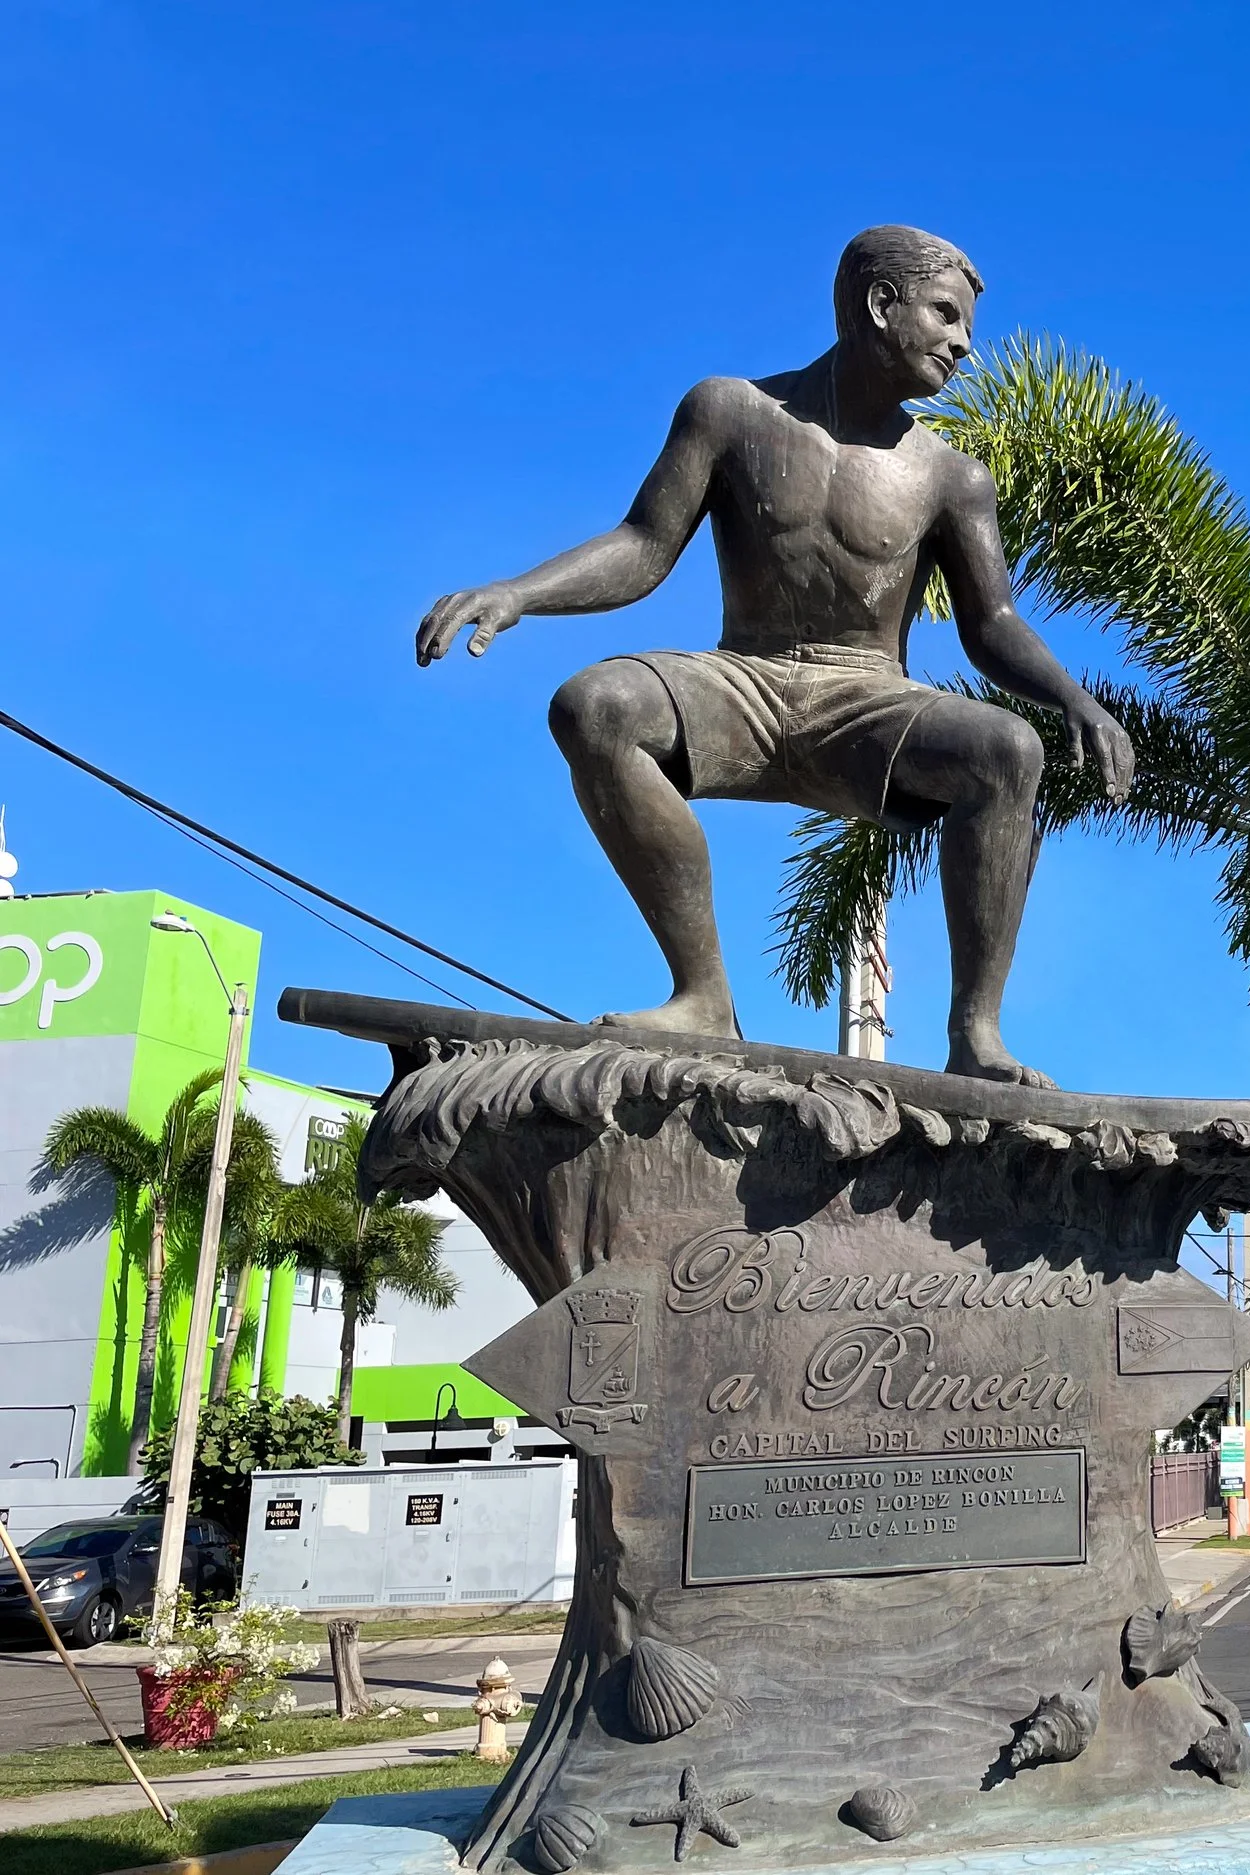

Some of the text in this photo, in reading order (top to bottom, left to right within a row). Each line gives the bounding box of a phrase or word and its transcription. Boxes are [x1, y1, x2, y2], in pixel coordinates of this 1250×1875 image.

[666, 1223, 1098, 1313] Bienvenidos
[707, 1322, 1081, 1414] a Rincón
[708, 1422, 1063, 1459] CAPITAL DEL SURFING
[765, 1464, 1017, 1494] MUNICIPIO DE RINCON
[266, 1510, 285, 1518] FUSE
[275, 1502, 294, 1510] MAIN
[708, 1486, 1066, 1522] HON. CARLOS LOPEZ BONILLA
[828, 1515, 959, 1541] ALCALDE
